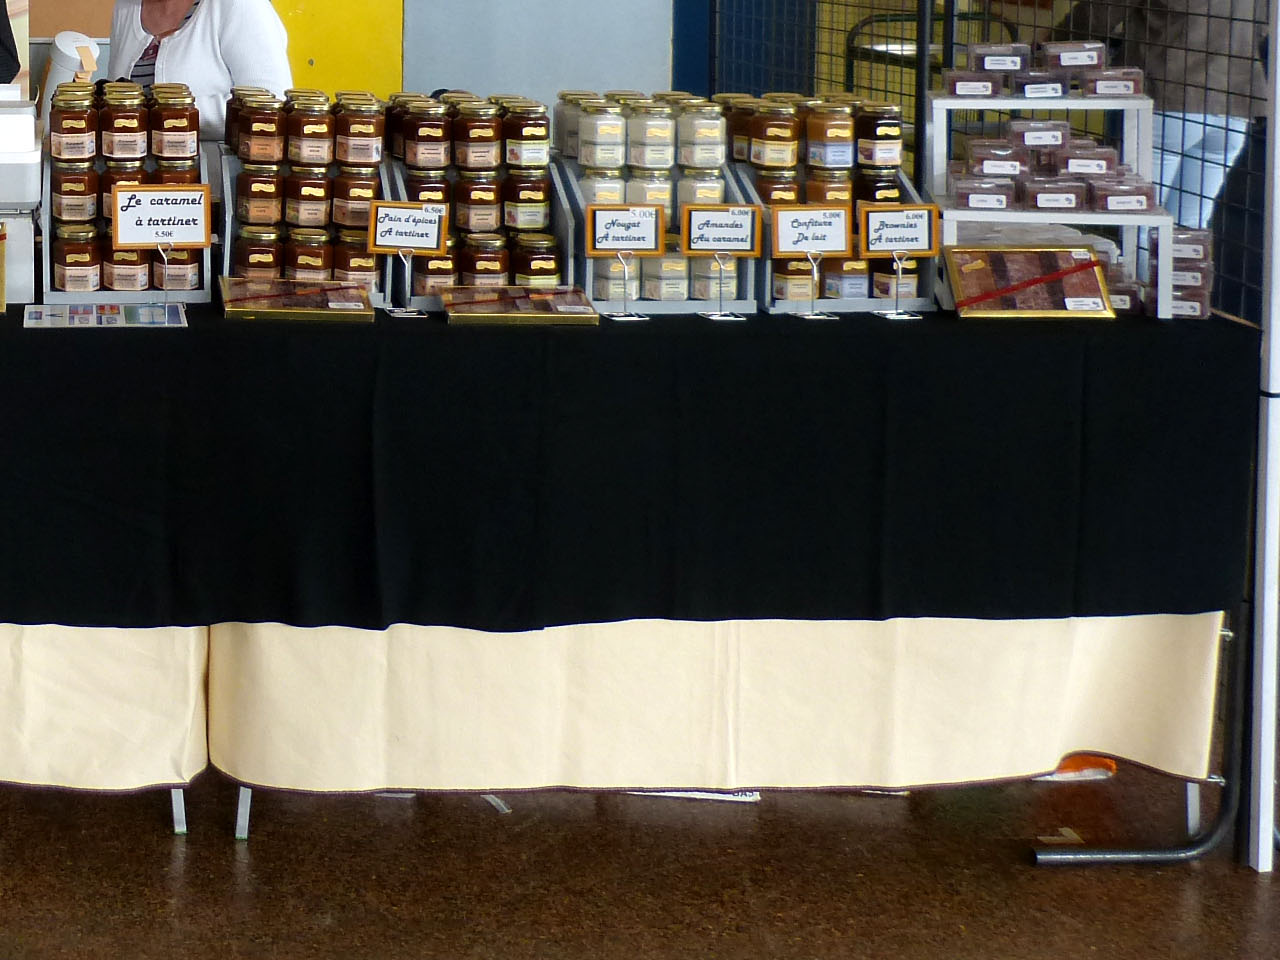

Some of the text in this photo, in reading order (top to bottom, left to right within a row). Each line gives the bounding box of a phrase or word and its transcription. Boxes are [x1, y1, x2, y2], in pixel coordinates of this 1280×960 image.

[120, 194, 203, 212] Le caramel
[135, 216, 198, 226] à tartiner
[378, 213, 436, 227] Pain d'épices
[605, 218, 641, 231] Nougat
[698, 220, 743, 230] Amandes
[791, 218, 832, 230] Confiture
[874, 221, 918, 233] Brownies
[155, 230, 174, 238] 5.50€
[395, 229, 430, 238] tartiner
[692, 234, 749, 244] Au caramel
[792, 232, 827, 245] De lait
[885, 235, 919, 243] tartiner
